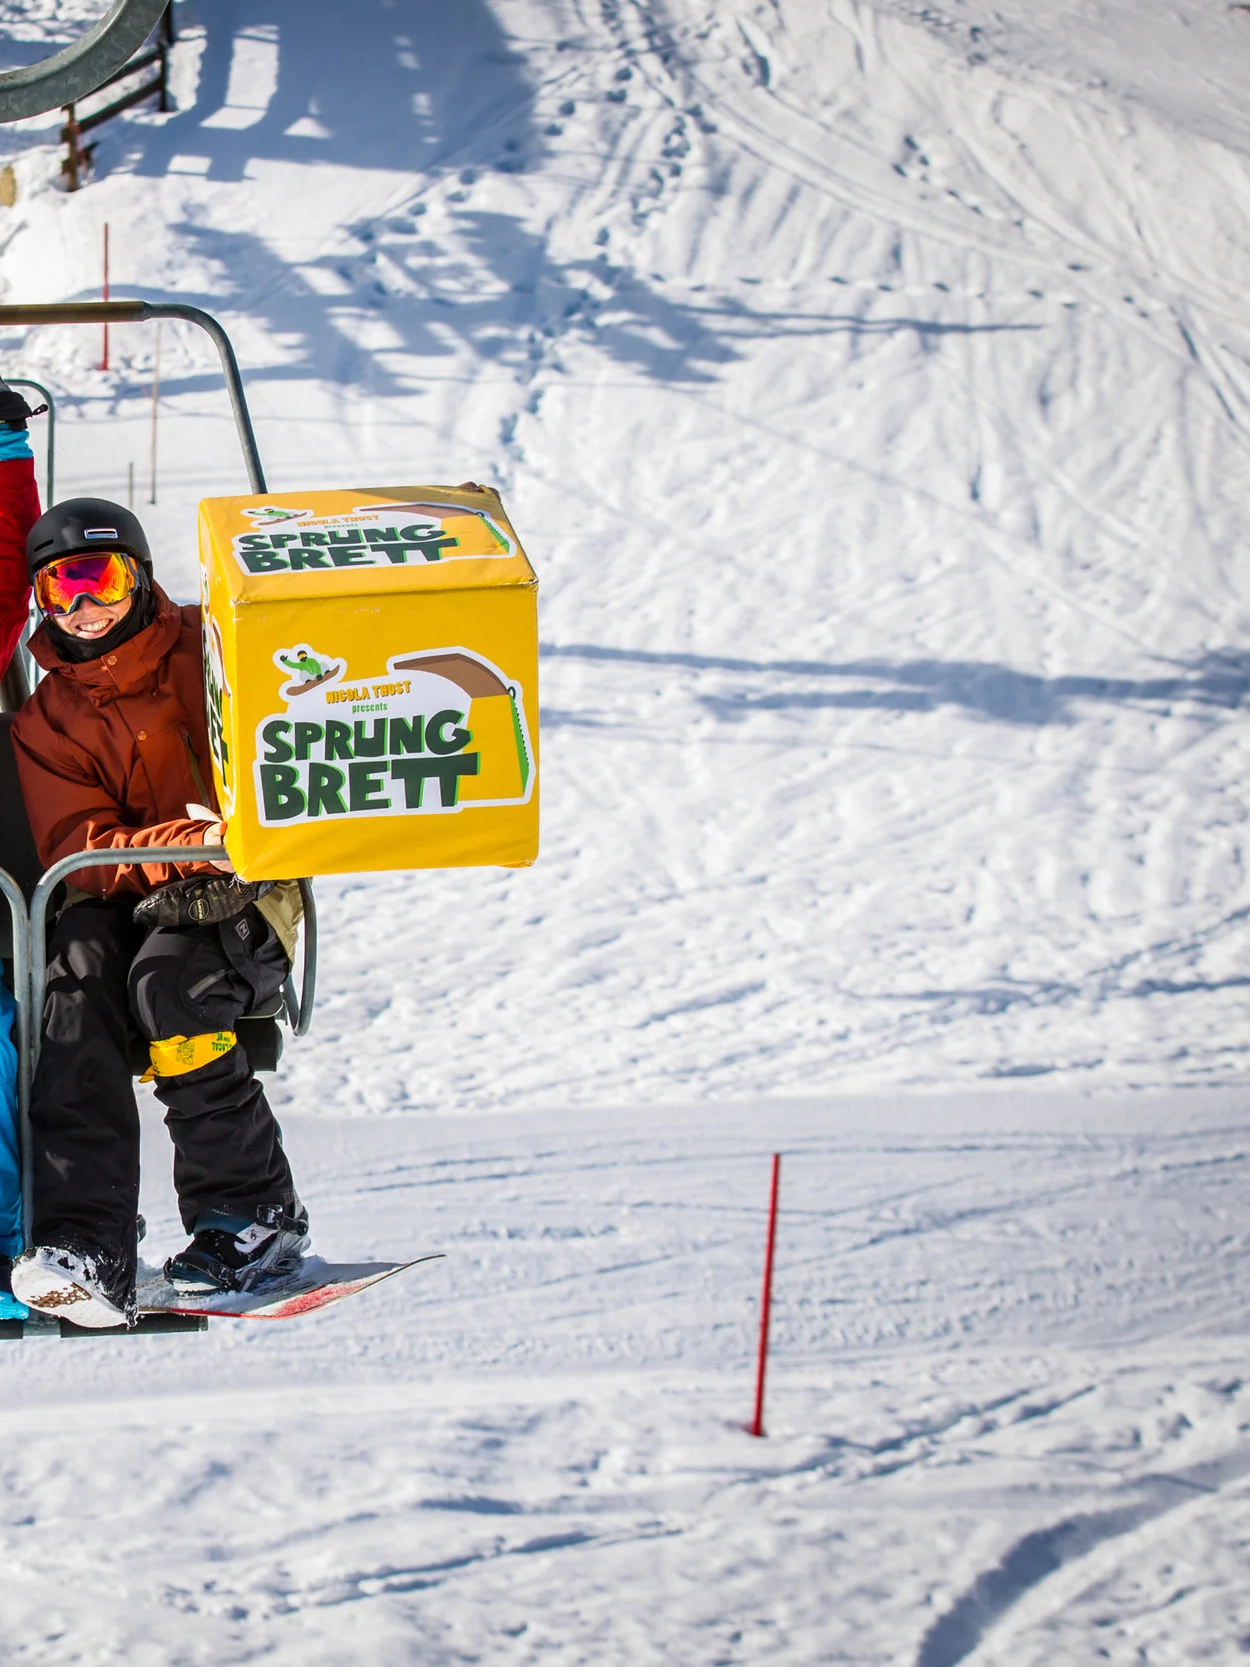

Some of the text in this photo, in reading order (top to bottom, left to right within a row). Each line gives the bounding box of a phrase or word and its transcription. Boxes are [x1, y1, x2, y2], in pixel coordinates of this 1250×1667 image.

[238, 524, 448, 550] SPRUNG
[241, 537, 460, 573] BRETT
[325, 680, 412, 704] NICOLA THOST
[351, 701, 388, 715] presents
[262, 709, 473, 763] SPRUNG
[260, 752, 480, 821] BRETT
